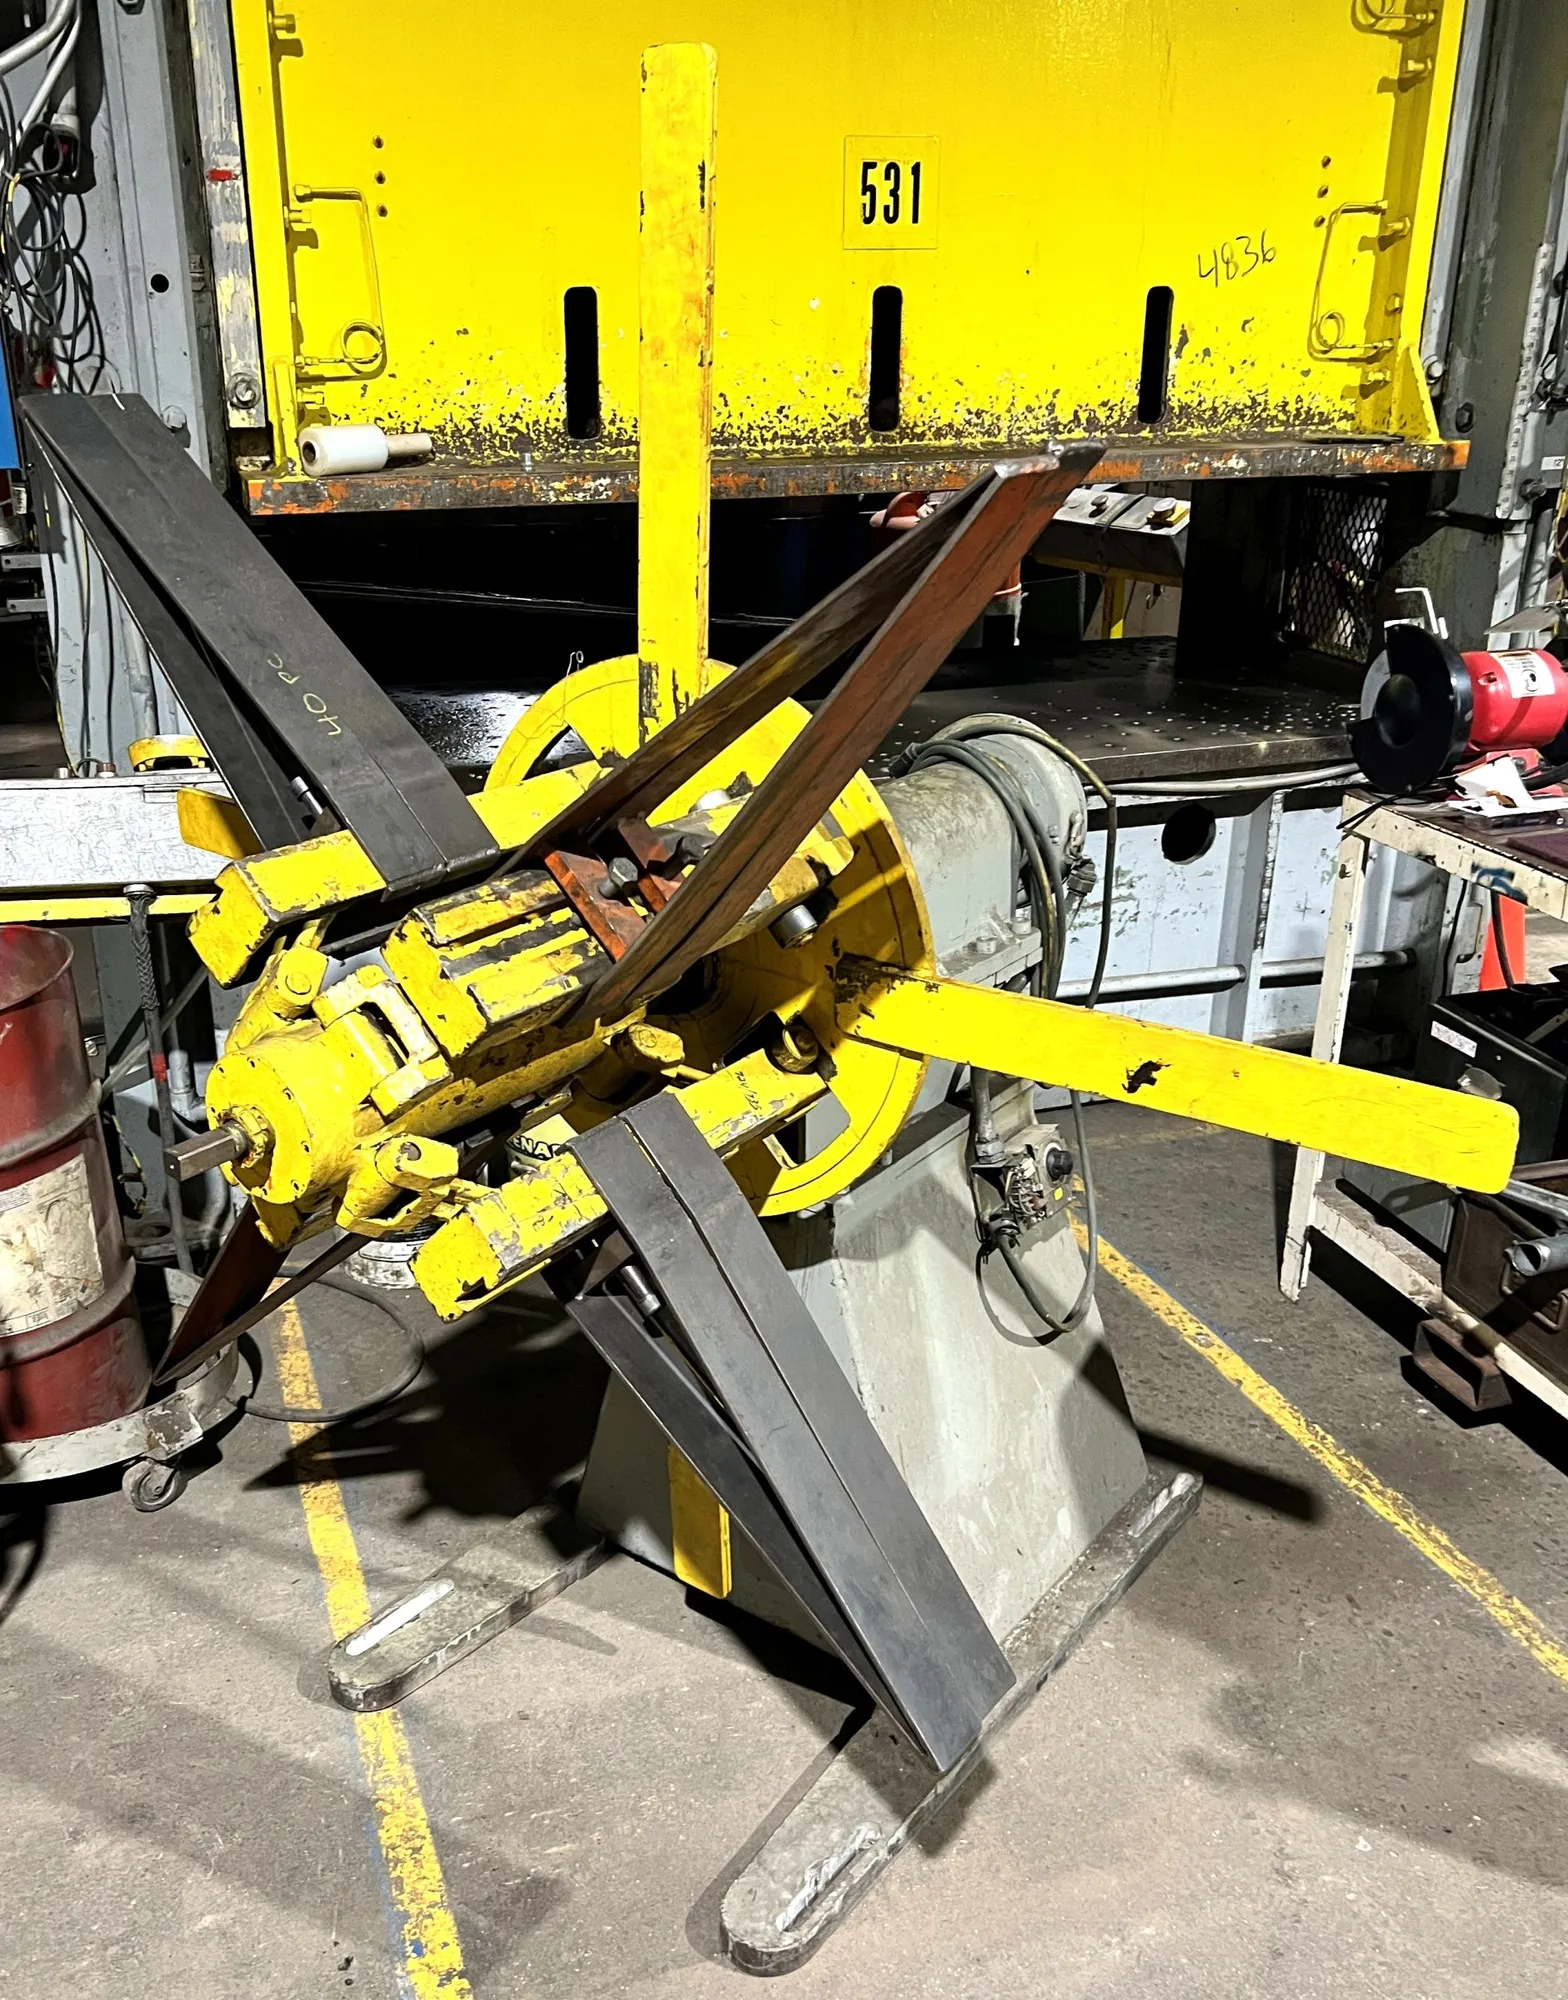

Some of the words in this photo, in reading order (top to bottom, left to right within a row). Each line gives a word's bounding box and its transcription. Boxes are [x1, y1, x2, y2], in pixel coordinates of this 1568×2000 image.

[861, 161, 921, 225] 531
[1197, 228, 1277, 288] 4836
[303, 692, 341, 736] 40
